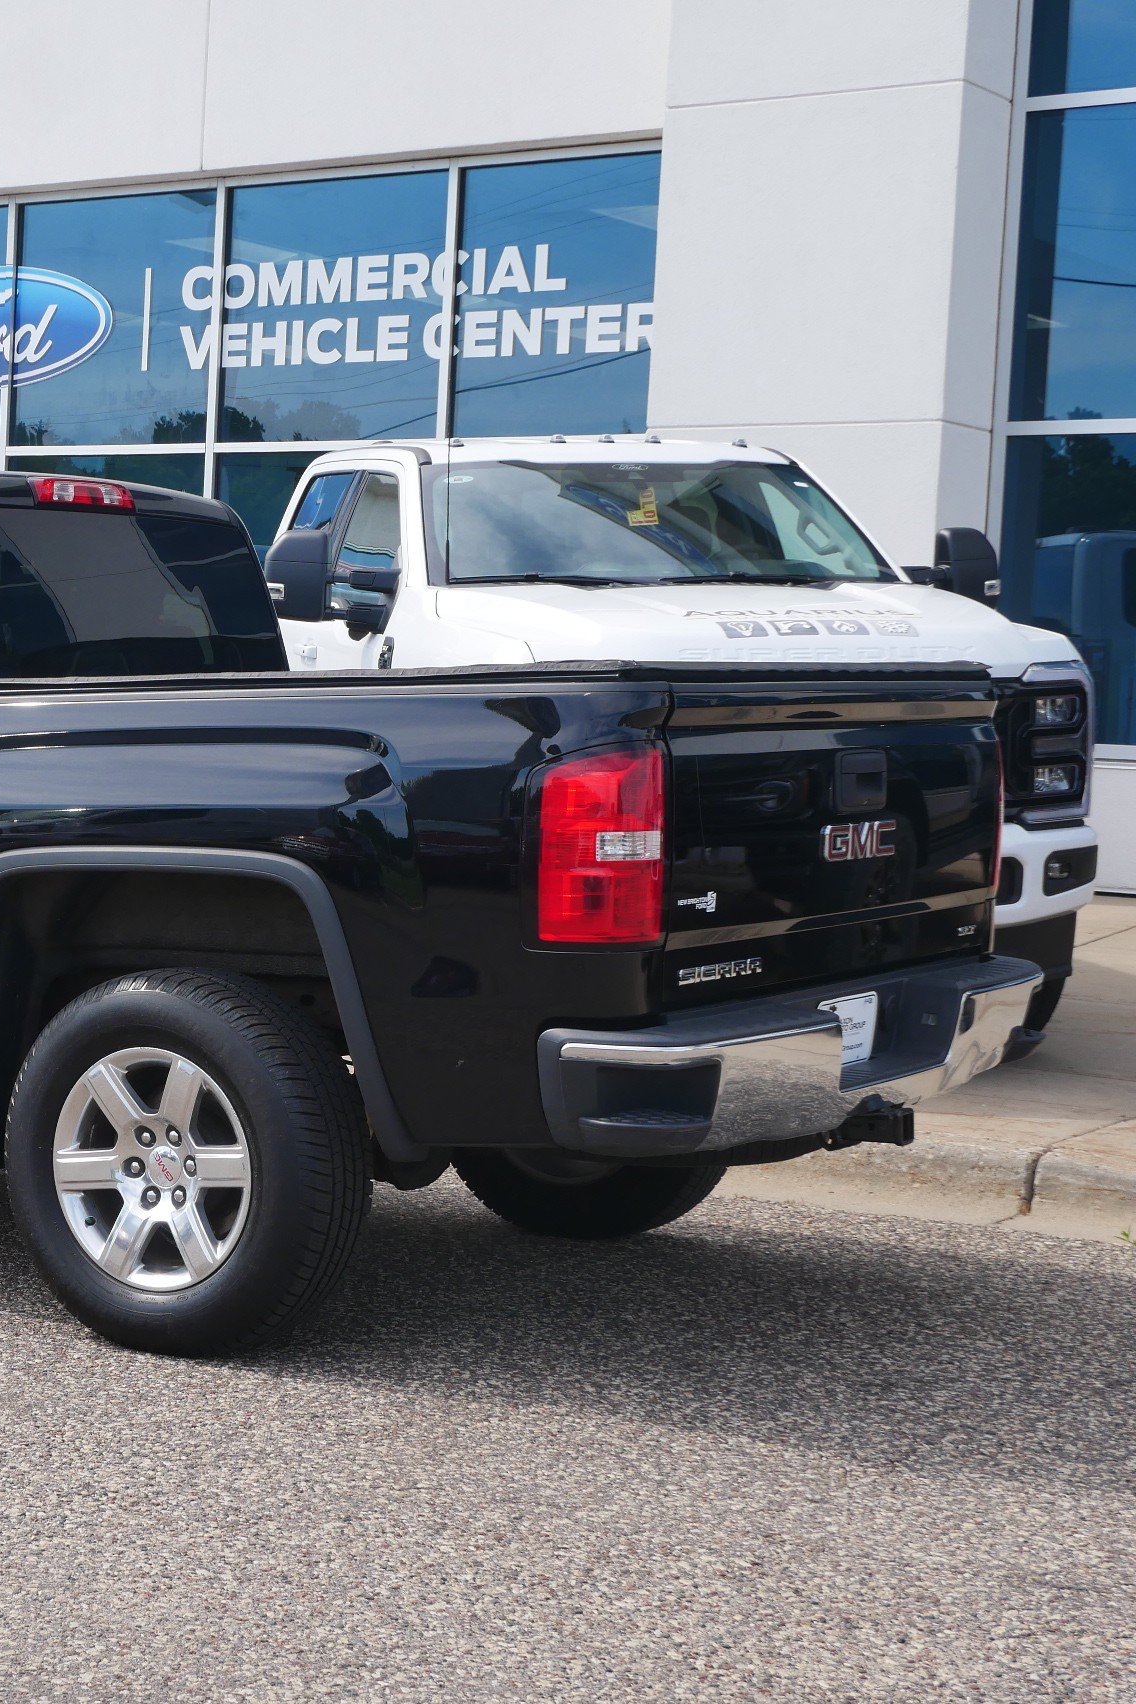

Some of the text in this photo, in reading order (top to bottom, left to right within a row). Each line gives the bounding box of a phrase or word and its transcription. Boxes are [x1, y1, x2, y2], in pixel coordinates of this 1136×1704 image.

[181, 243, 567, 311] COMMERCIAL
[179, 302, 655, 370] VEHICLE CENTER
[682, 608, 915, 618] AQUARIUS
[677, 645, 975, 662] SUPER DUTY
[821, 820, 896, 862] GMC
[678, 957, 762, 986] SIERRA
[153, 1151, 174, 1182] GMC
